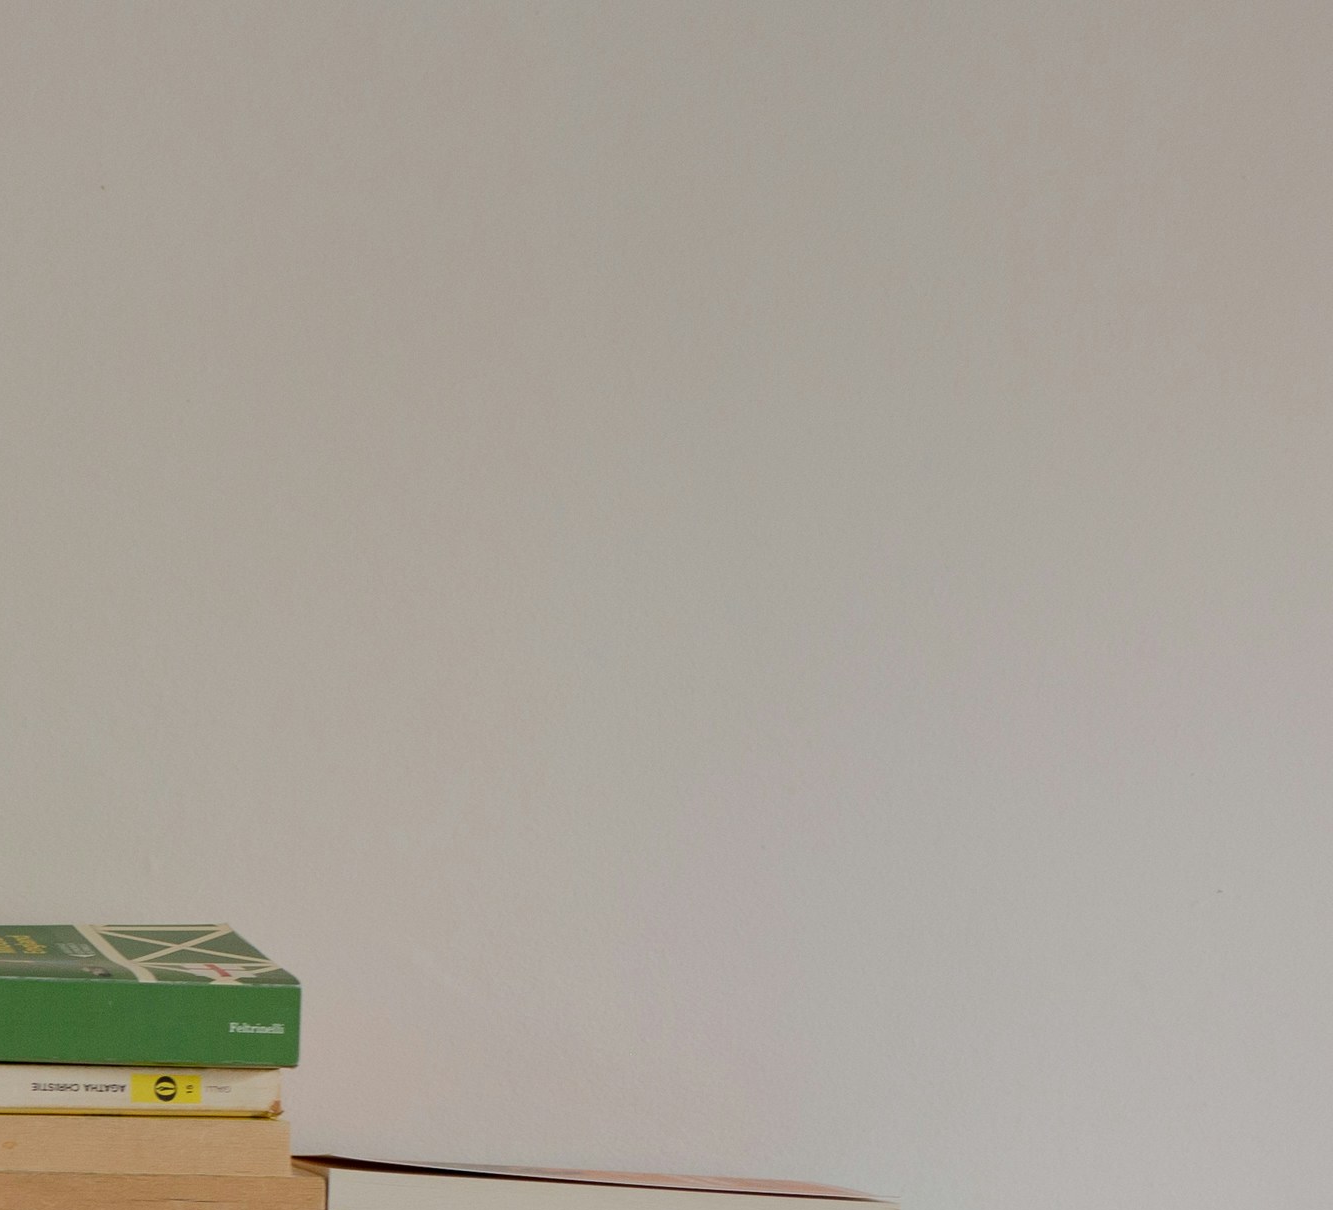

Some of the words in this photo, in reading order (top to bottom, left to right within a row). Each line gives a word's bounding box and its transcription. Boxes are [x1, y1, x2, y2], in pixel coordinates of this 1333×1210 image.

[228, 1022, 285, 1035] Feltrinelli
[31, 1082, 80, 1093] CHRISTIE
[83, 1083, 127, 1093] AGATHA
